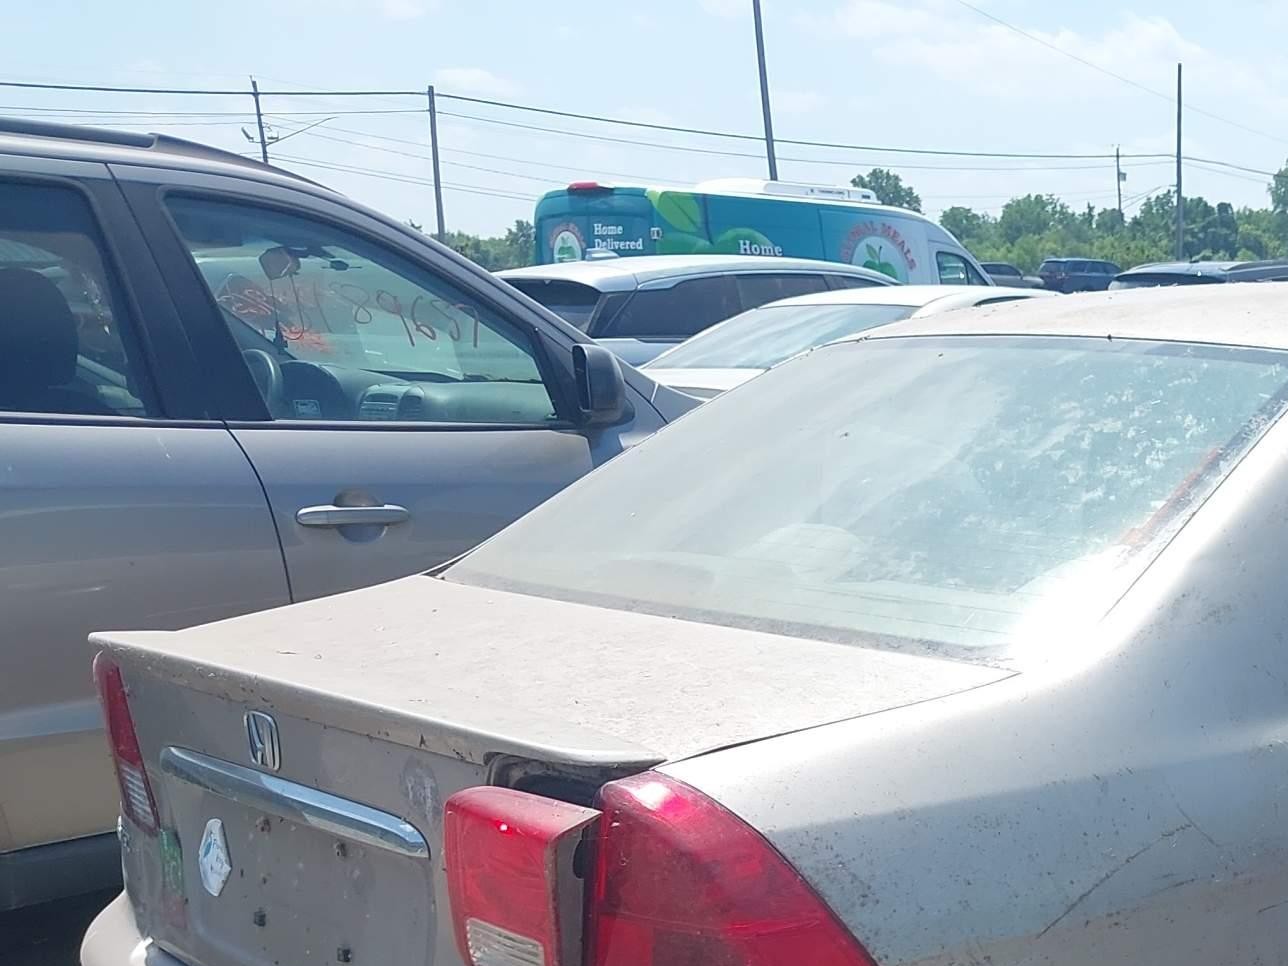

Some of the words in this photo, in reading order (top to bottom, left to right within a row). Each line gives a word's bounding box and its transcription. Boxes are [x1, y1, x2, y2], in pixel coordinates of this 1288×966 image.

[593, 223, 624, 235] Home
[594, 238, 643, 250] Delivered
[738, 240, 783, 257] Home
